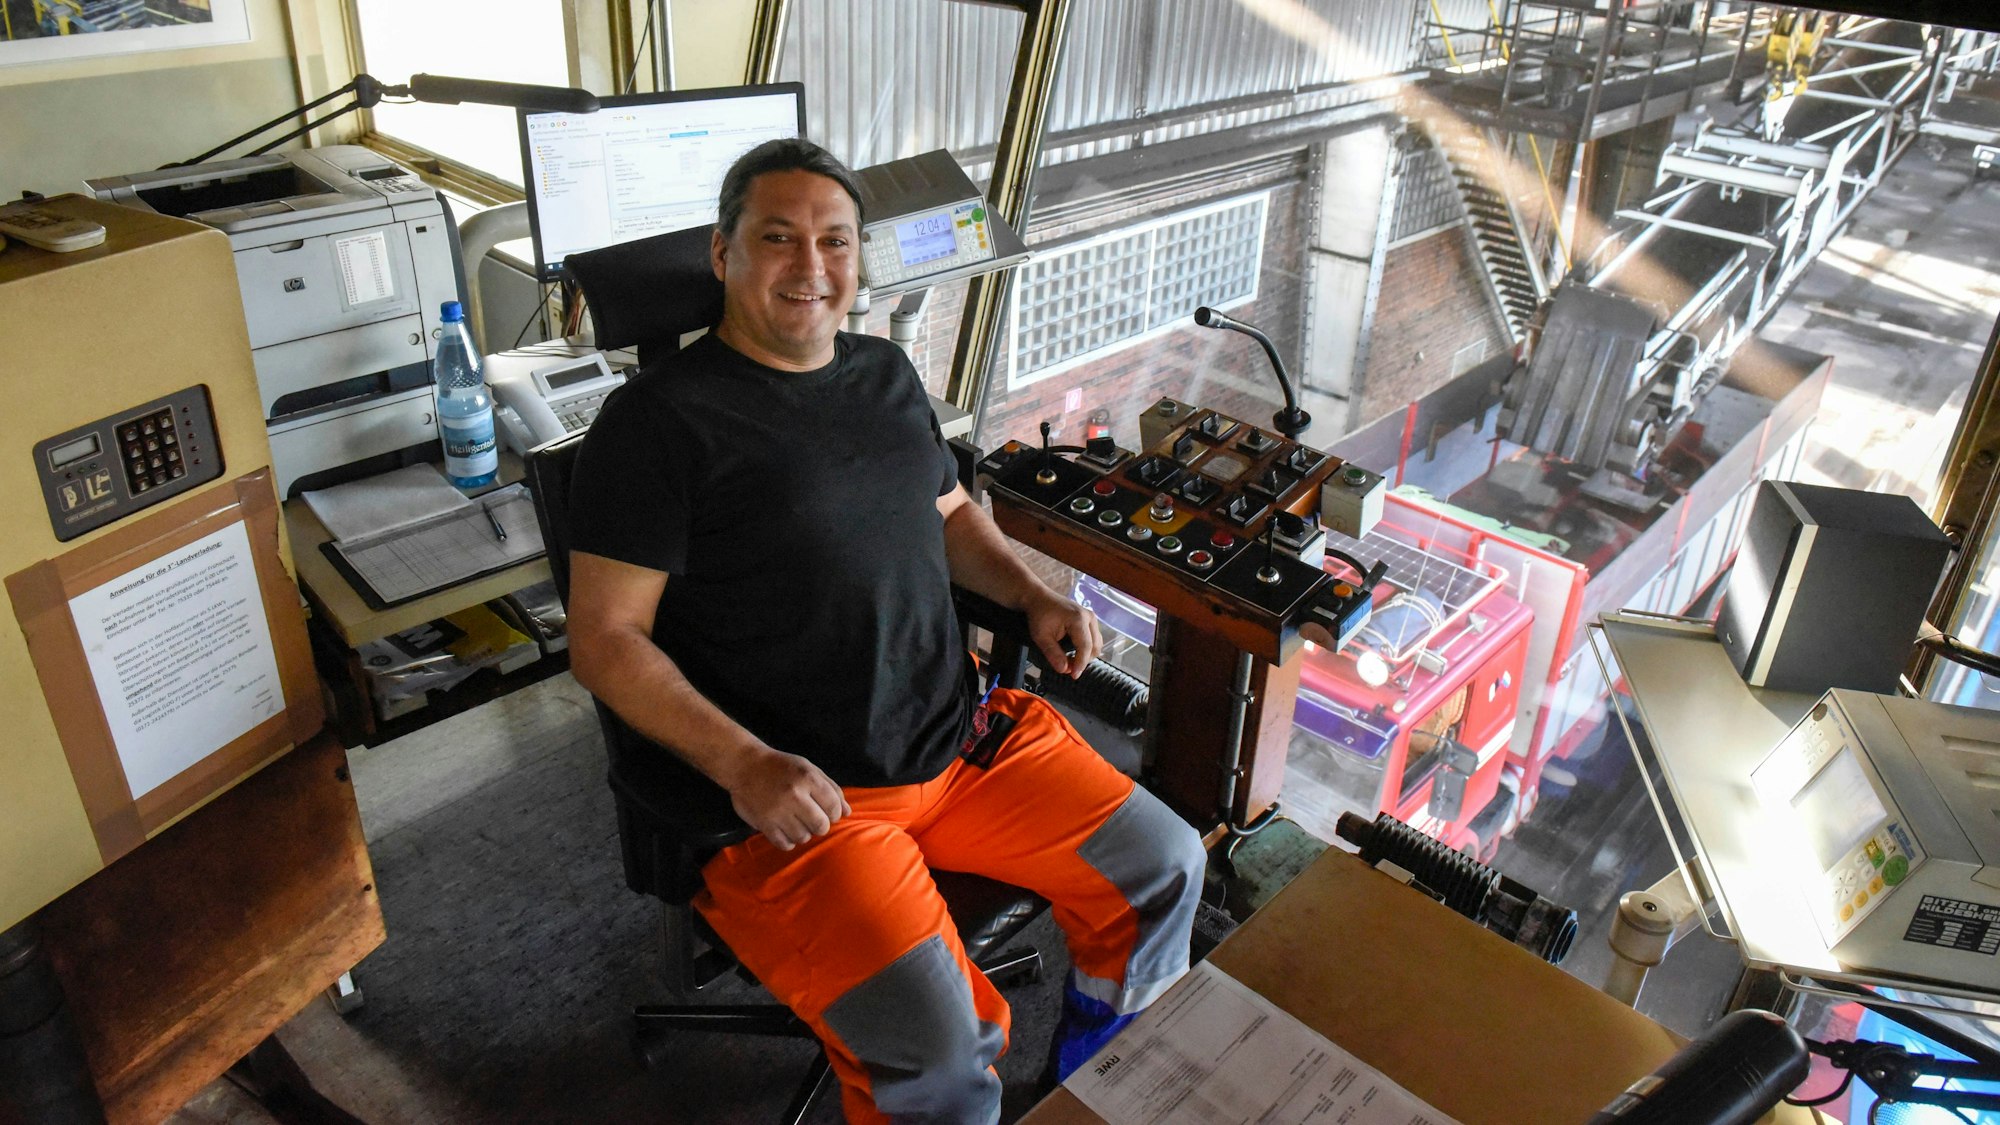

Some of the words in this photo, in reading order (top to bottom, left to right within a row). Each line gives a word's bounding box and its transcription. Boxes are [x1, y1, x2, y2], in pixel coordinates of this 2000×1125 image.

[109, 578, 145, 599] Anweisung
[145, 572, 156, 581] für
[156, 567, 166, 576] die
[111, 604, 135, 618] Verlader
[135, 595, 154, 606] meldet
[207, 555, 235, 571] Frühschicht
[104, 623, 117, 632] nach
[117, 609, 145, 625] Aufnahme
[106, 624, 131, 639] Einrichter
[132, 616, 146, 626] unter
[113, 646, 136, 661] Befinden
[152, 656, 169, 667] führen
[170, 646, 188, 657] können
[118, 660, 144, 677] Störungen
[125, 682, 153, 700] umgehend
[162, 662, 190, 680] Disposition
[130, 700, 156, 717] Außerhalb
[1923, 896, 1980, 911] BITZER
[1094, 1055, 1121, 1077] RWE
